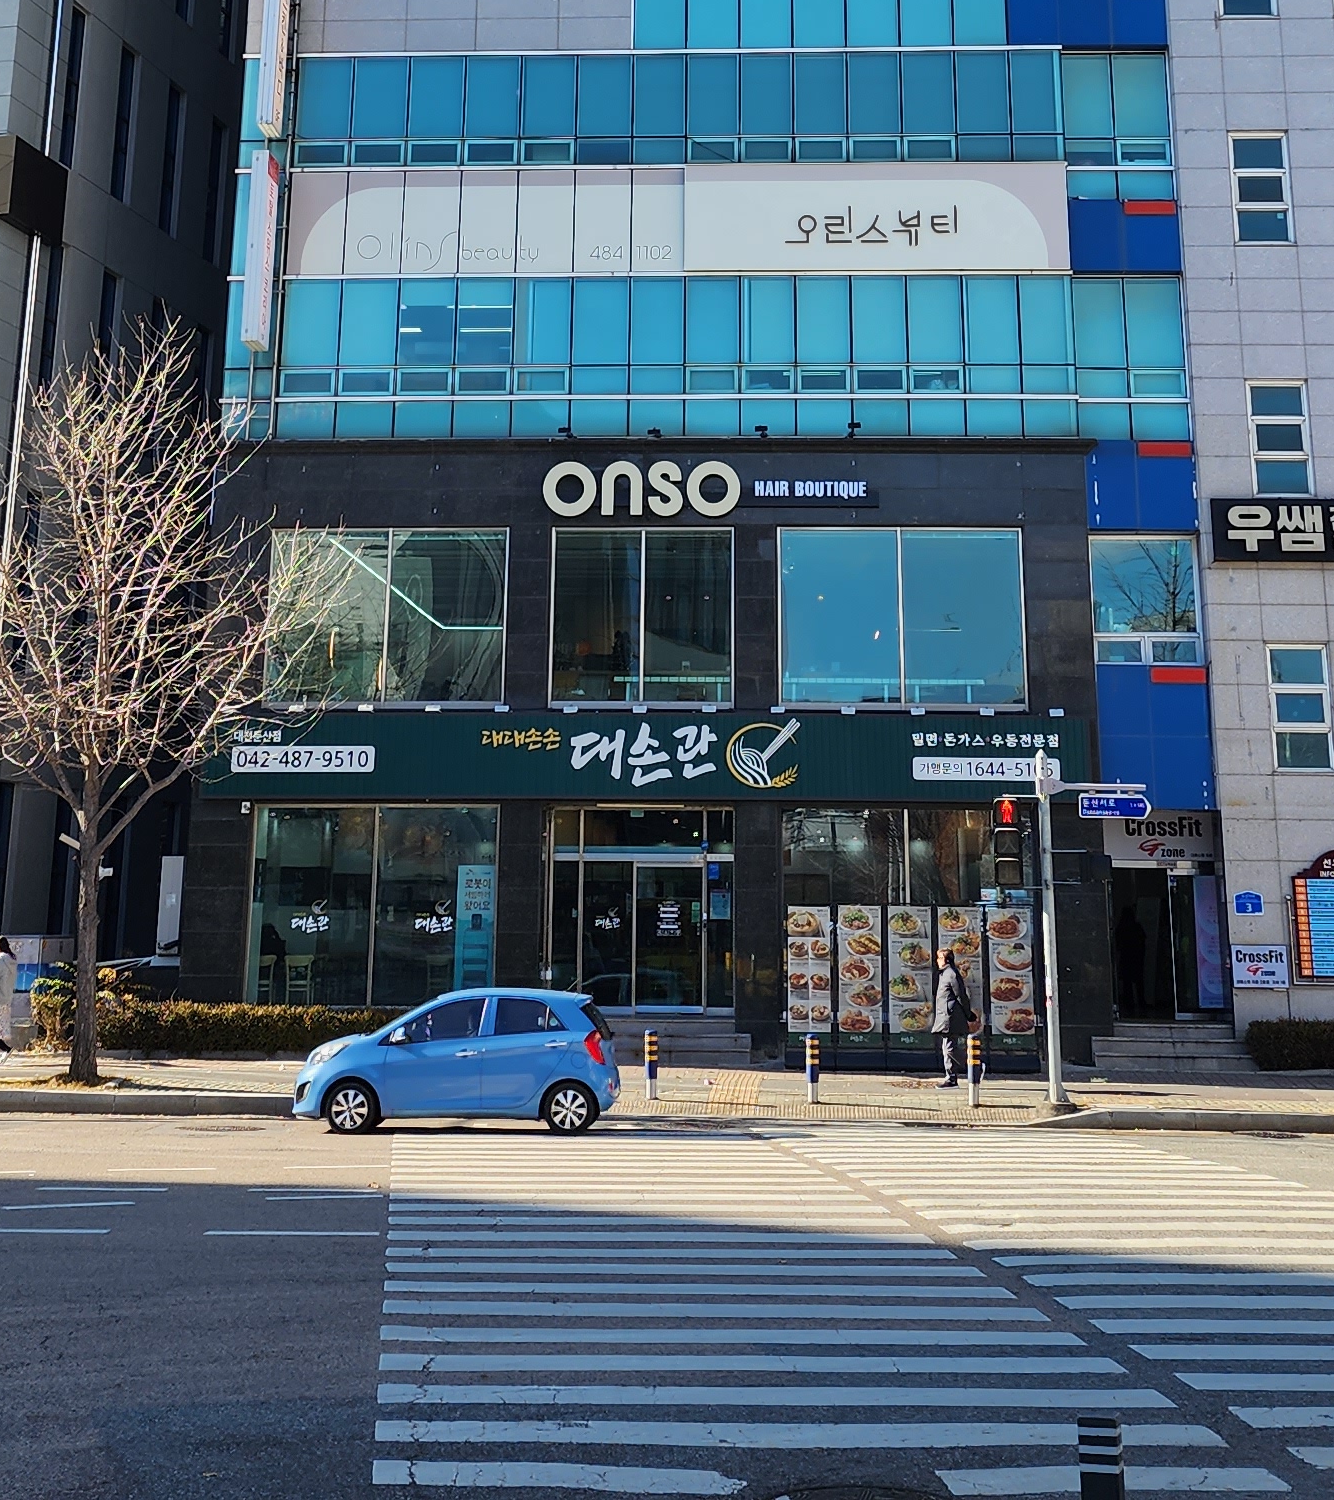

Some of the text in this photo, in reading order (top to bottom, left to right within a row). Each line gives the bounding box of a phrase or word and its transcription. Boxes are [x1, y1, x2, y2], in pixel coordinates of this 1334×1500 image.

[785, 205, 958, 247] 오린스뷰티
[461, 235, 540, 263] beauty
[589, 245, 624, 260] 484
[636, 245, 672, 260] 1102
[754, 480, 790, 497] HAIR
[794, 481, 867, 498] BOUTIQUE
[1227, 505, 1326, 552] 우쌤
[481, 727, 561, 751] 대대손손
[236, 750, 369, 768] 042-487-9510
[570, 722, 719, 787] 대손관
[920, 761, 1054, 777] 가맹문의 1644-51
[1125, 817, 1203, 837] CrossFit
[1161, 848, 1185, 858] zone
[1246, 903, 1253, 912] 3
[291, 915, 330, 934] 대손관
[415, 916, 453, 934] 대손관
[1235, 950, 1284, 963] CrossFit
